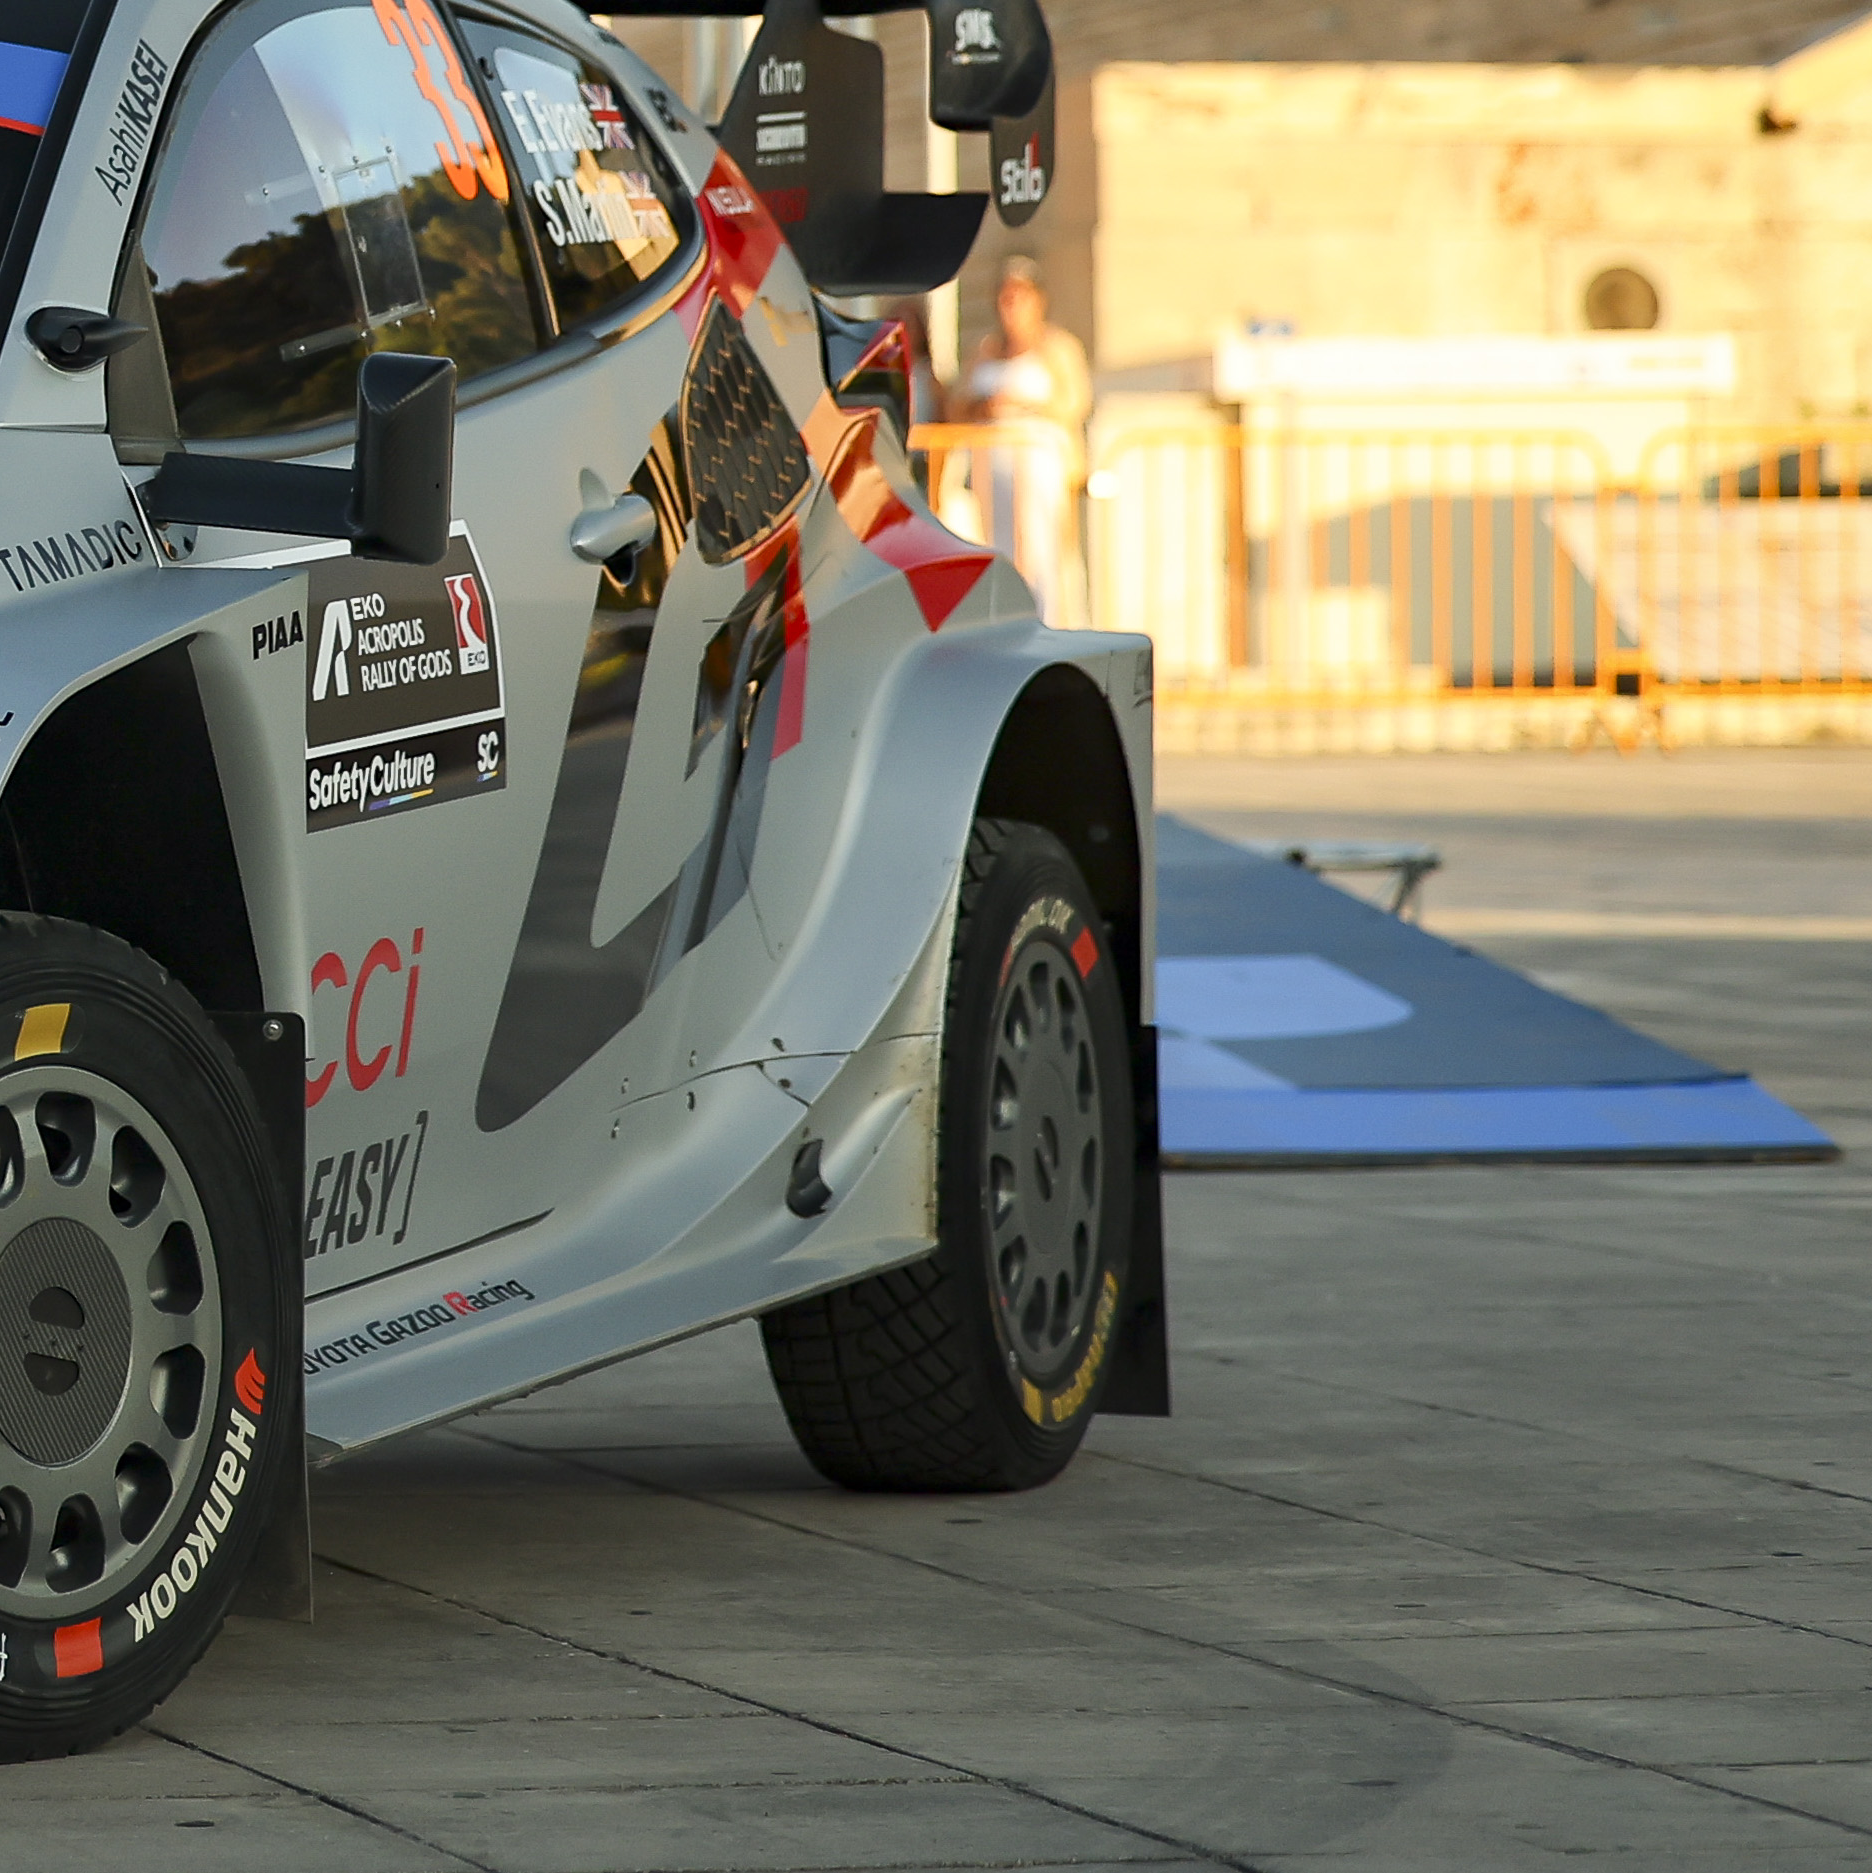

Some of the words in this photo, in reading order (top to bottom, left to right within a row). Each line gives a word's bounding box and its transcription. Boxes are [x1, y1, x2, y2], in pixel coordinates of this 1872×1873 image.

[350, 593, 385, 621] EKO
[252, 610, 304, 660] PIAA
[358, 618, 425, 656] ACROPOLIS
[361, 657, 399, 692] RALLY
[399, 654, 416, 684] OF
[417, 649, 452, 680] GODS
[309, 750, 435, 812] SafetyCulture
[477, 731, 499, 773] SC
[303, 1334, 379, 1375] OYOTA
[366, 1305, 456, 1346] GAZOO
[443, 1279, 535, 1316] Racing
